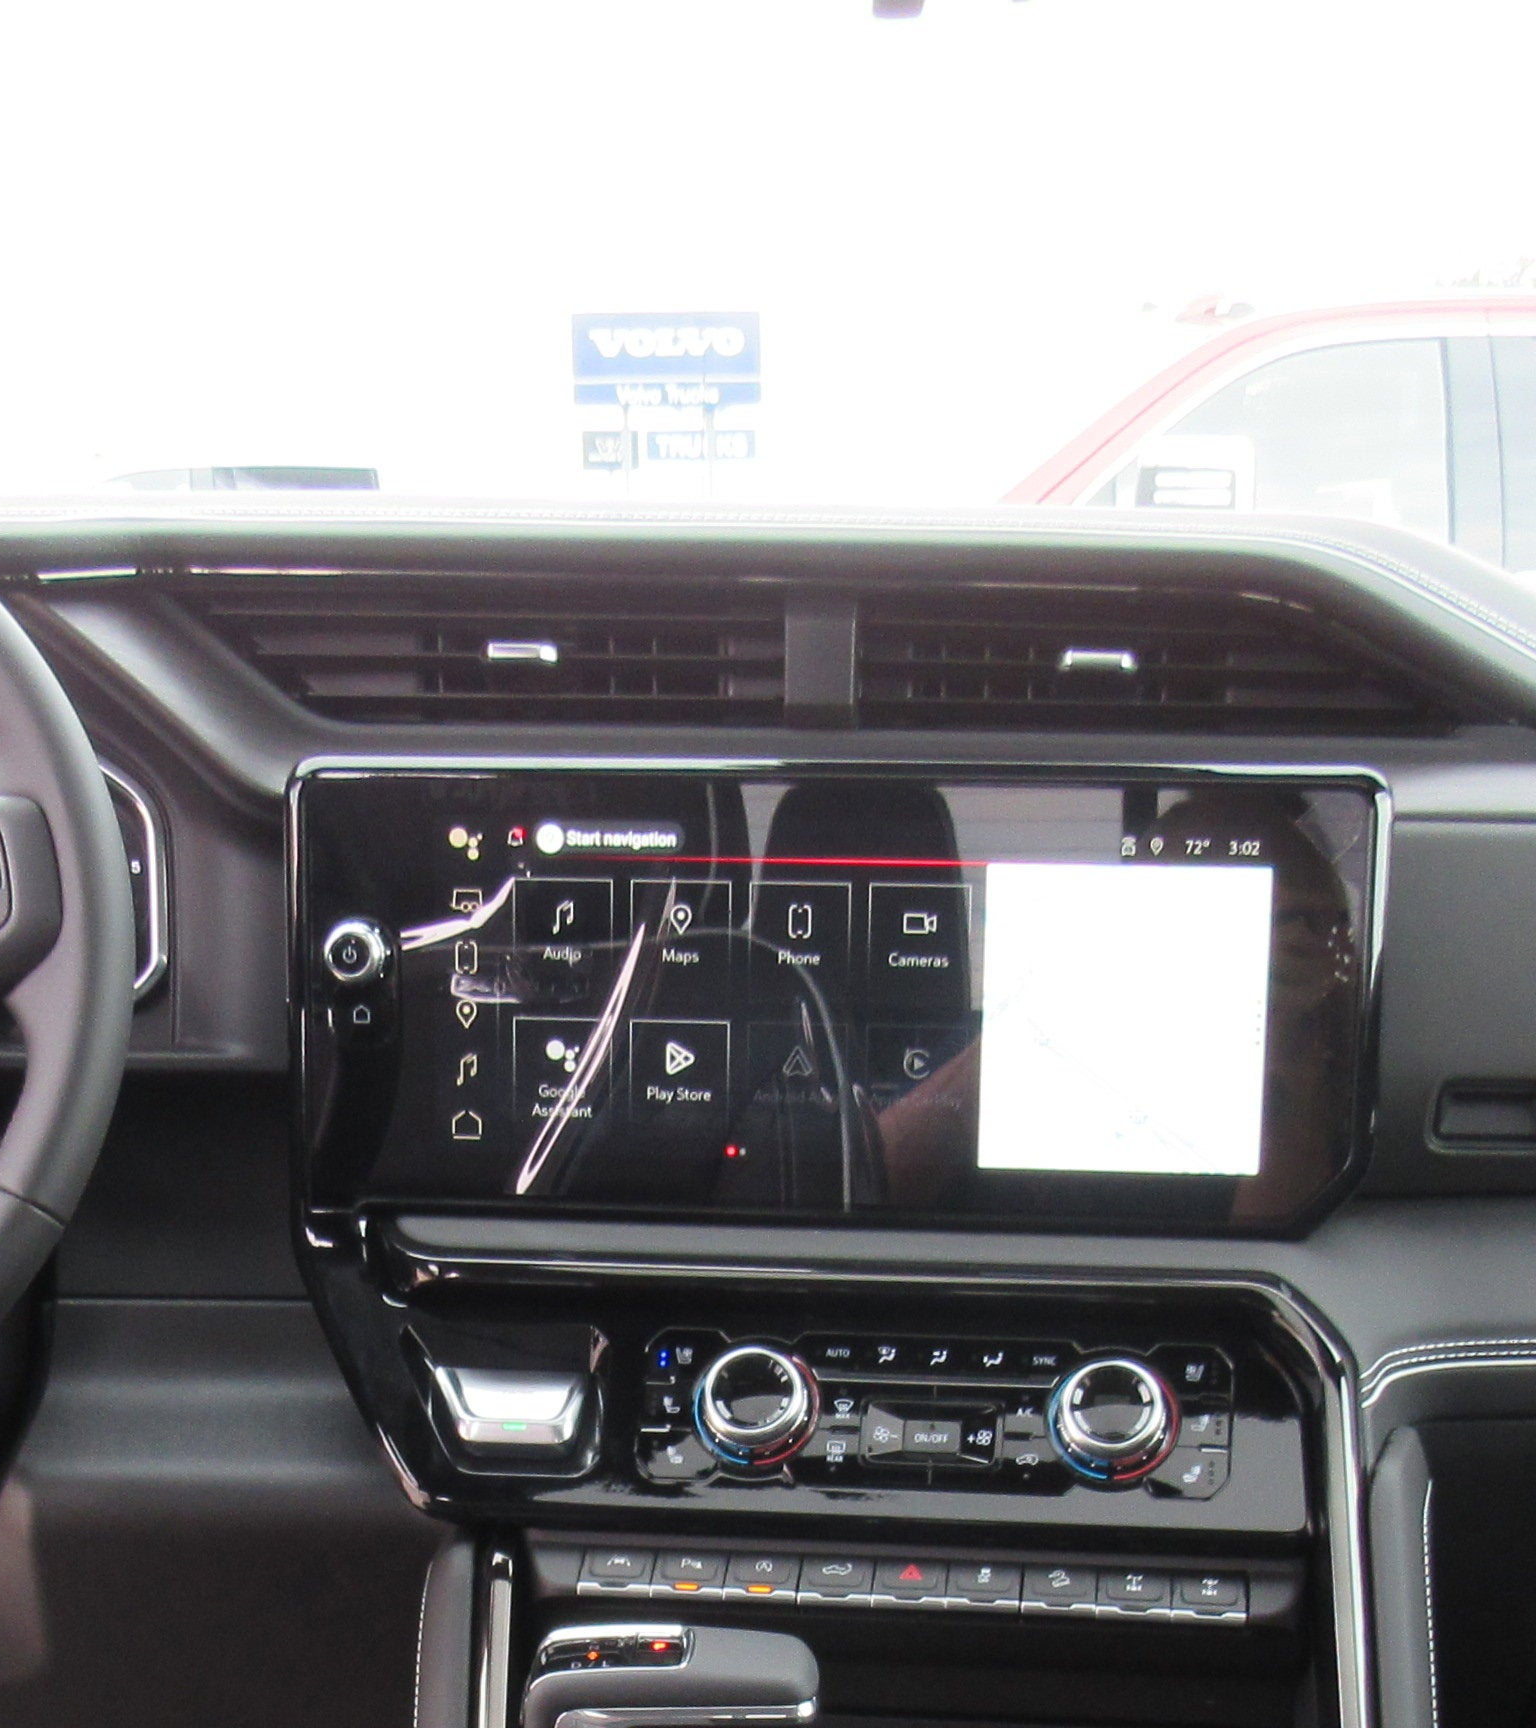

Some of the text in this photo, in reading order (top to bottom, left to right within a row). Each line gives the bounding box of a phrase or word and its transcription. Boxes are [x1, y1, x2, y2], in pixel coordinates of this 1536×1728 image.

[588, 326, 746, 358] VOLVO
[616, 382, 719, 406] Volvo Trucks
[566, 830, 676, 850] Start navigation
[1228, 840, 1261, 857] 3:02
[543, 946, 582, 962] Audio
[662, 949, 699, 965] Maps
[777, 950, 820, 966] Phone
[888, 953, 949, 968] Cameras
[646, 1086, 711, 1104] Play Store
[531, 1103, 593, 1118] Asssant
[825, 1348, 851, 1359] AUTO
[1031, 1355, 1057, 1366] SYNC
[914, 1432, 949, 1444] ON/OFF
